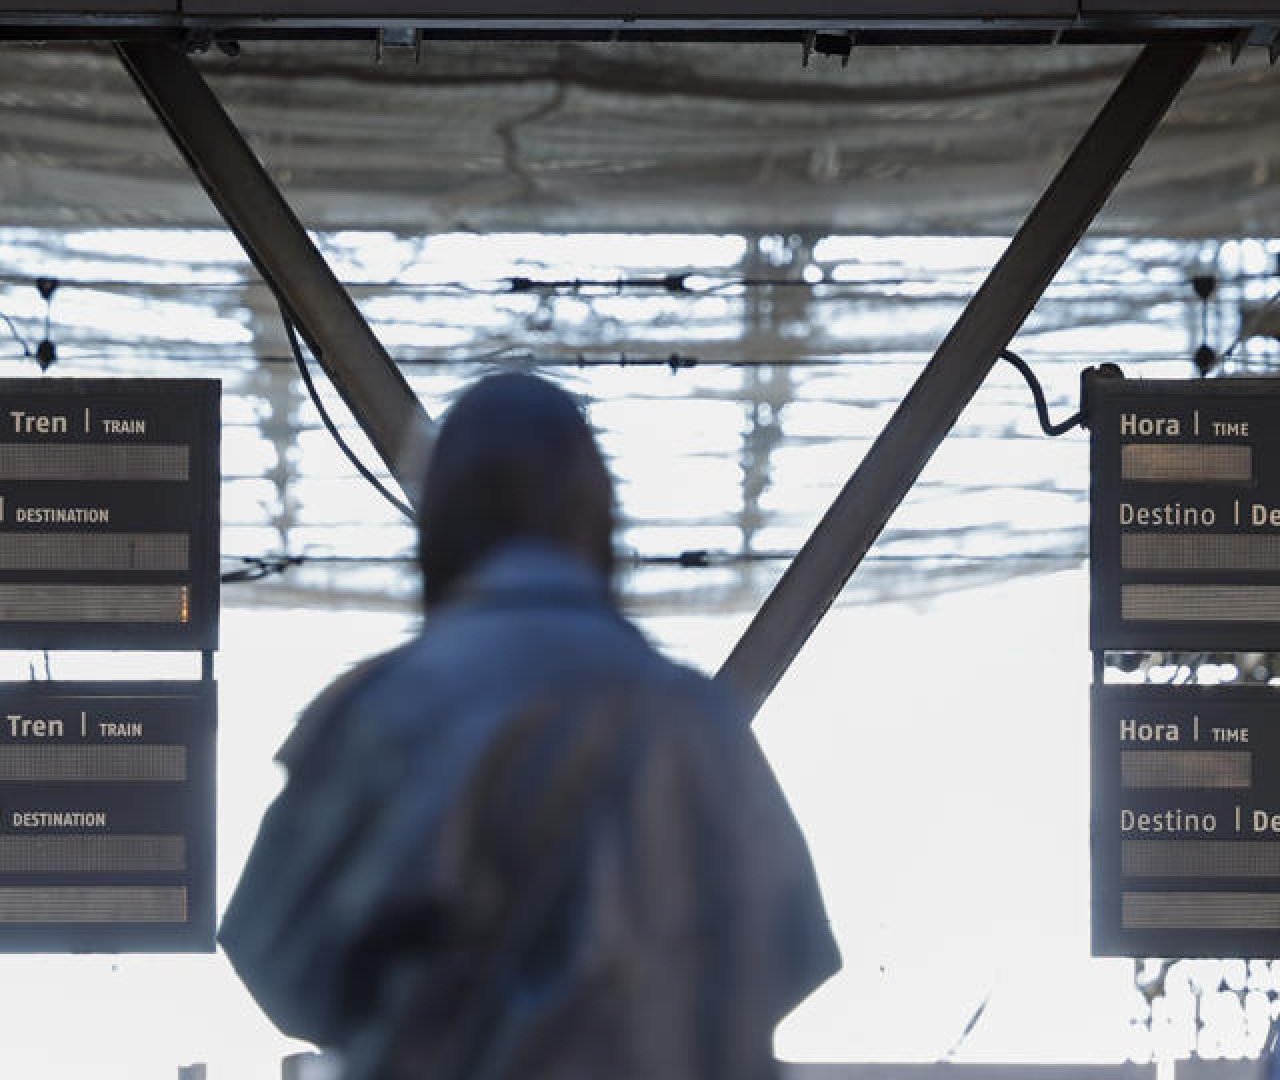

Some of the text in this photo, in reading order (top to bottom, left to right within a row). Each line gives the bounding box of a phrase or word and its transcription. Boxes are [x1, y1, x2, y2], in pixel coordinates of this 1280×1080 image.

[10, 412, 66, 432] Tren
[104, 420, 144, 432] TRAIN
[1122, 414, 1178, 434] Hora
[1214, 424, 1248, 436] TIME
[16, 508, 108, 522] DESTINATION
[1120, 504, 1214, 525] Destino
[6, 716, 62, 736] Tren
[100, 724, 142, 736] TRAIN
[1120, 720, 1178, 740] Hora
[1212, 728, 1248, 742] TIME
[14, 812, 104, 826] DESTINATION
[1122, 810, 1216, 832] Destino
